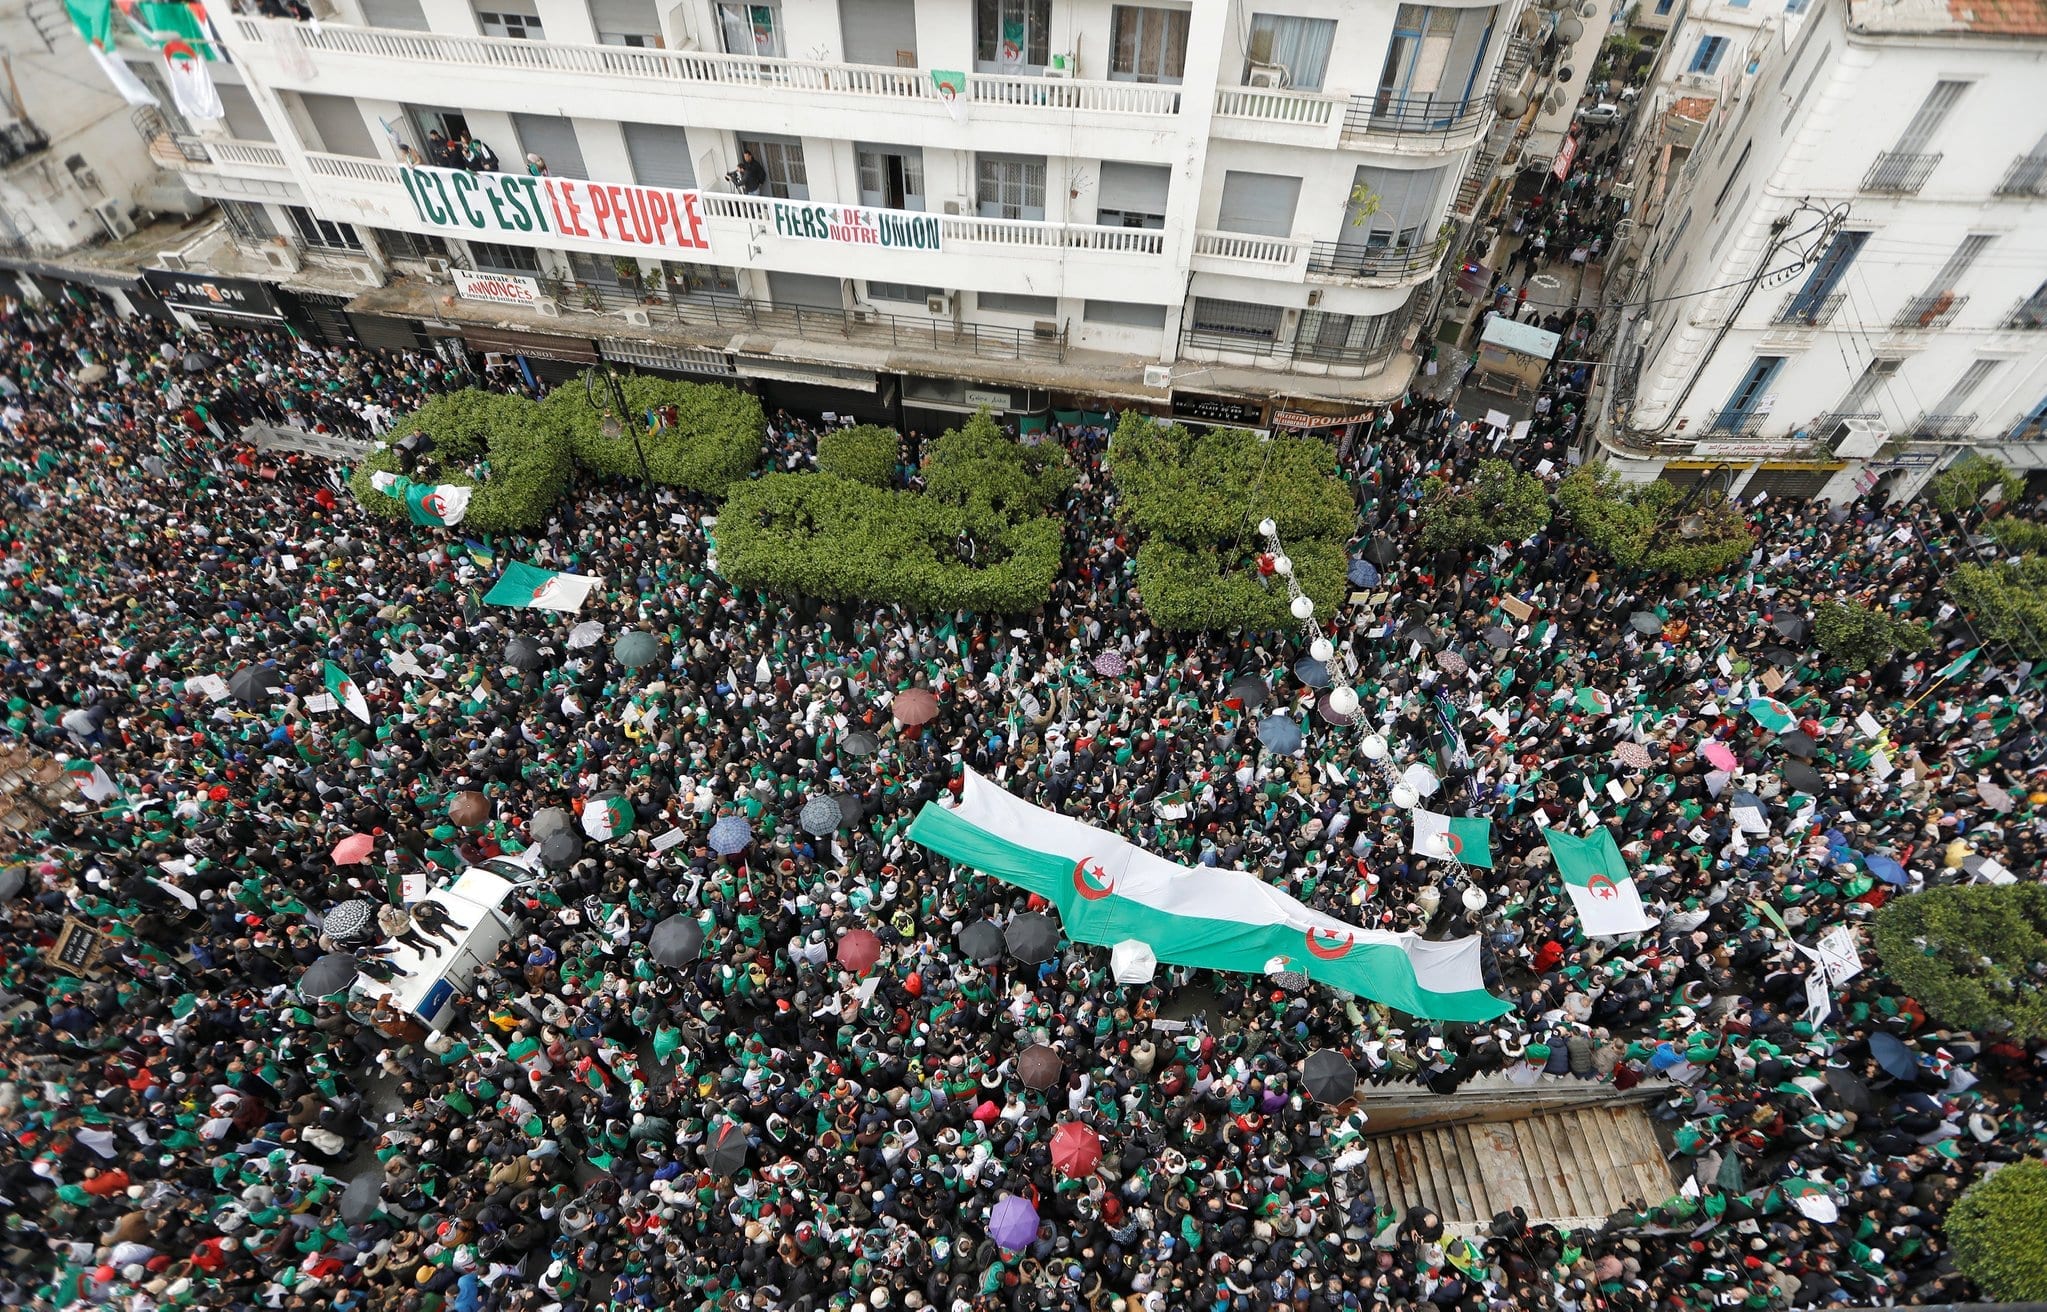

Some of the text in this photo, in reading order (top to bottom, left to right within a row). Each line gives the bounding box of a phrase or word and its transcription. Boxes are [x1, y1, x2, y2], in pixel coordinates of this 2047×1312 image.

[400, 166, 709, 249] ICI C'EST LE PEUPLE
[774, 202, 940, 250] FIERS DE NOTRE UNION
